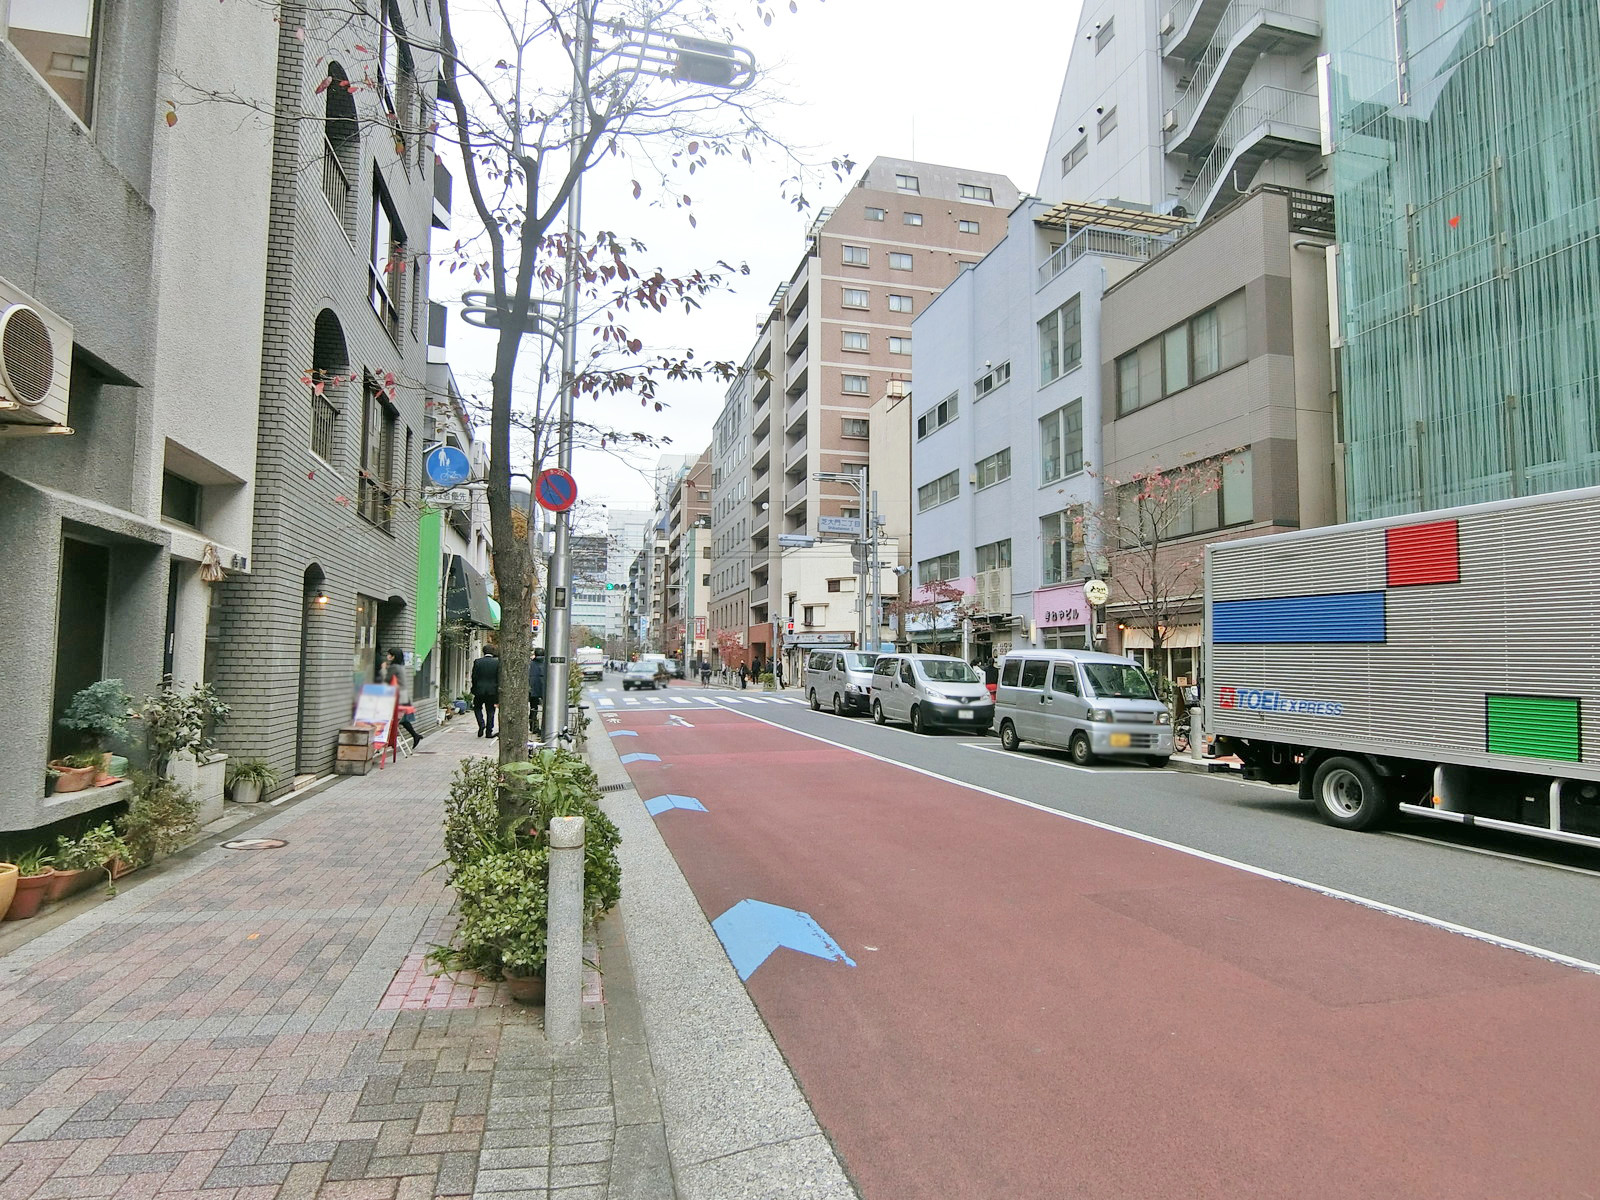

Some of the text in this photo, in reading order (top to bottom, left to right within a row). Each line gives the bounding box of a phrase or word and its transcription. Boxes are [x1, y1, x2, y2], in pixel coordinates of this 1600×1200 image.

[821, 518, 860, 528] 芝大門二丁目
[1236, 688, 1343, 716] TOEI EXPRESS
